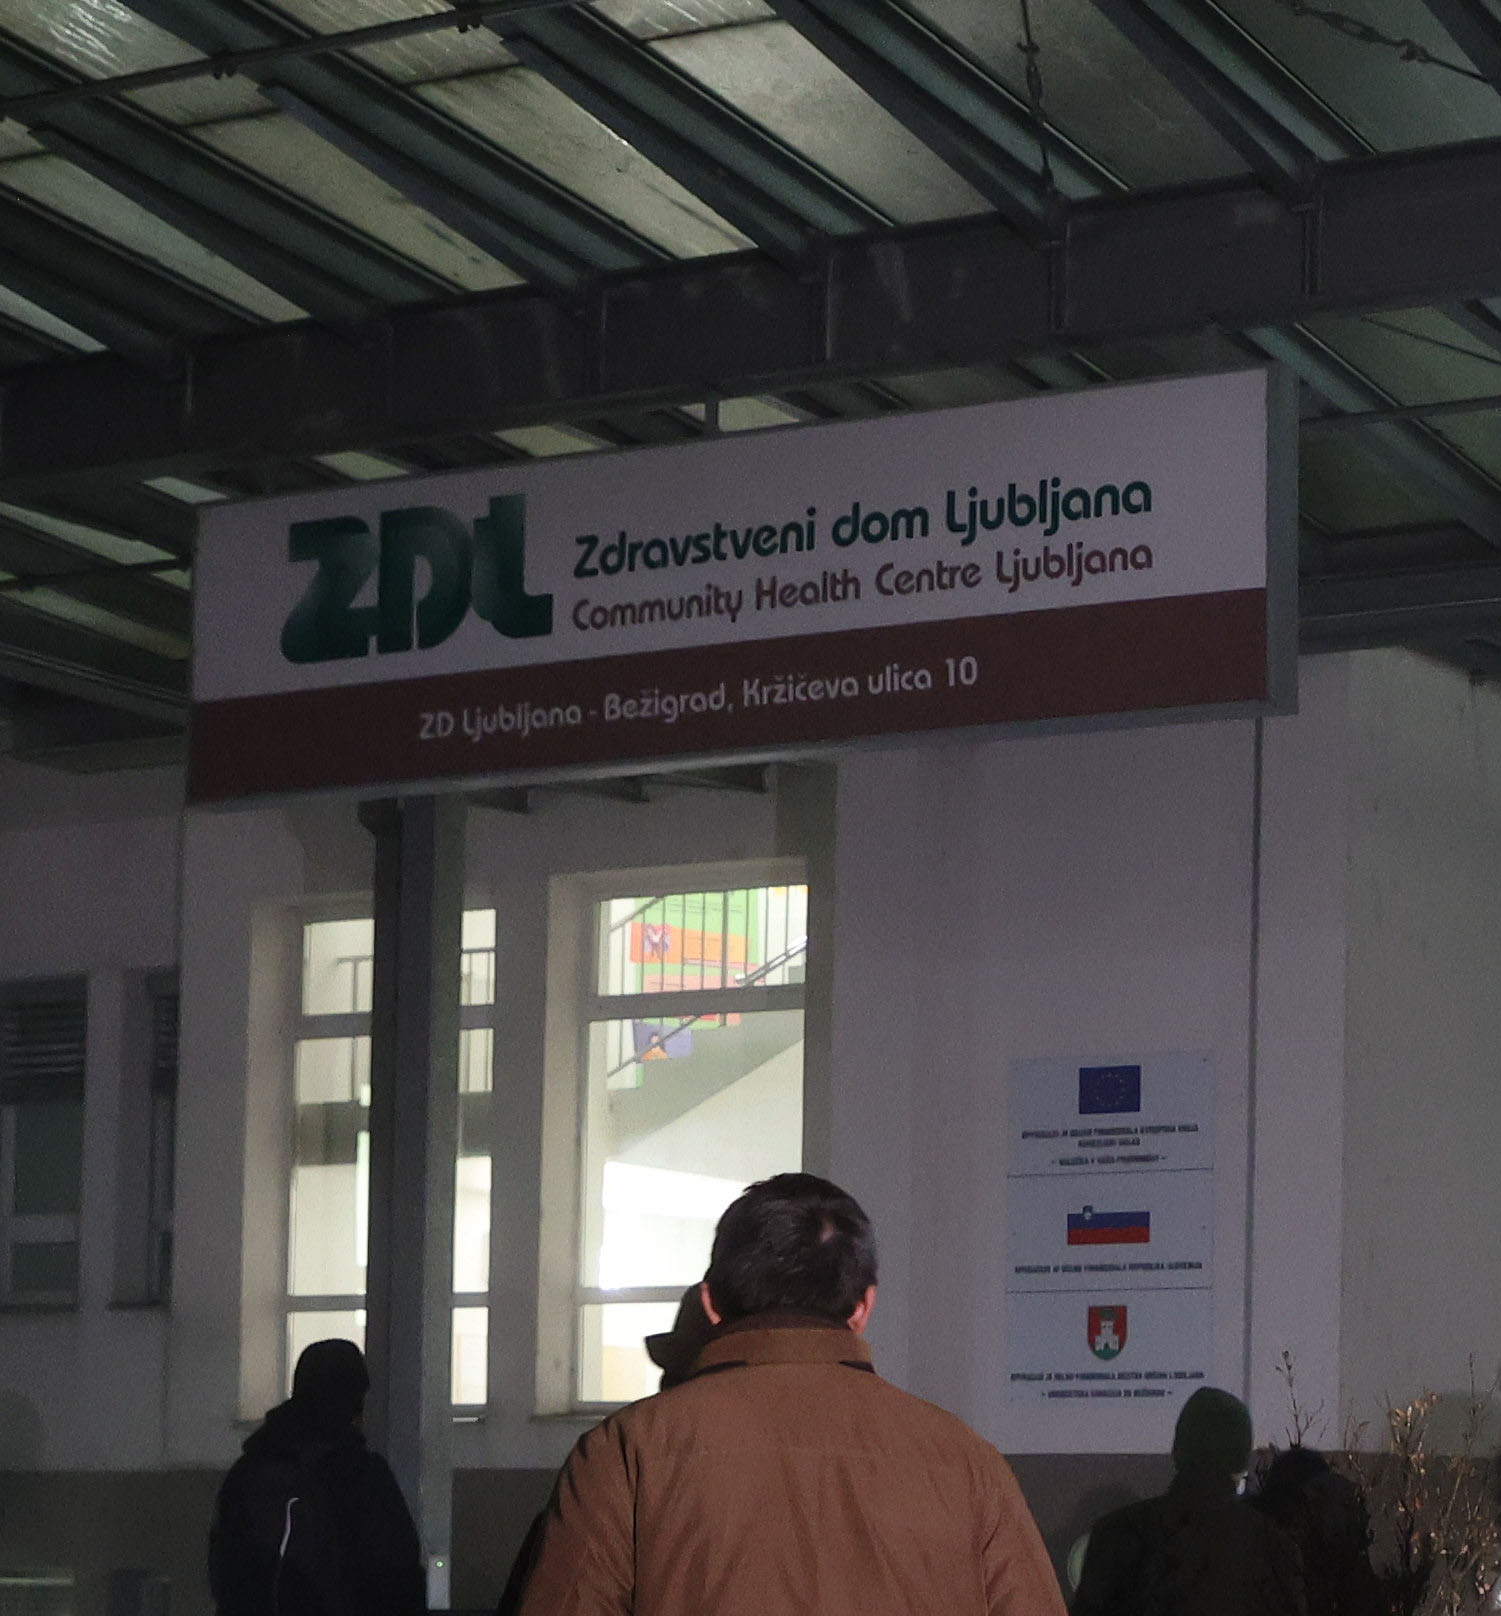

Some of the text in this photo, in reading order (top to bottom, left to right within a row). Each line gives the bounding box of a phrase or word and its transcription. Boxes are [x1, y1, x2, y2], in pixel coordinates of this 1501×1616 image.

[573, 477, 1152, 577] Zdravstveni dom Ljubljana
[280, 494, 553, 664] ZDL
[572, 541, 1153, 631] Community Health Centre Ljubljana
[420, 713, 453, 740] ZD
[462, 702, 581, 742] Ljubljana
[604, 682, 734, 723] Bežigrad,
[743, 671, 859, 708] Kržičeva
[869, 663, 932, 694] ulica
[945, 655, 978, 686] 10
